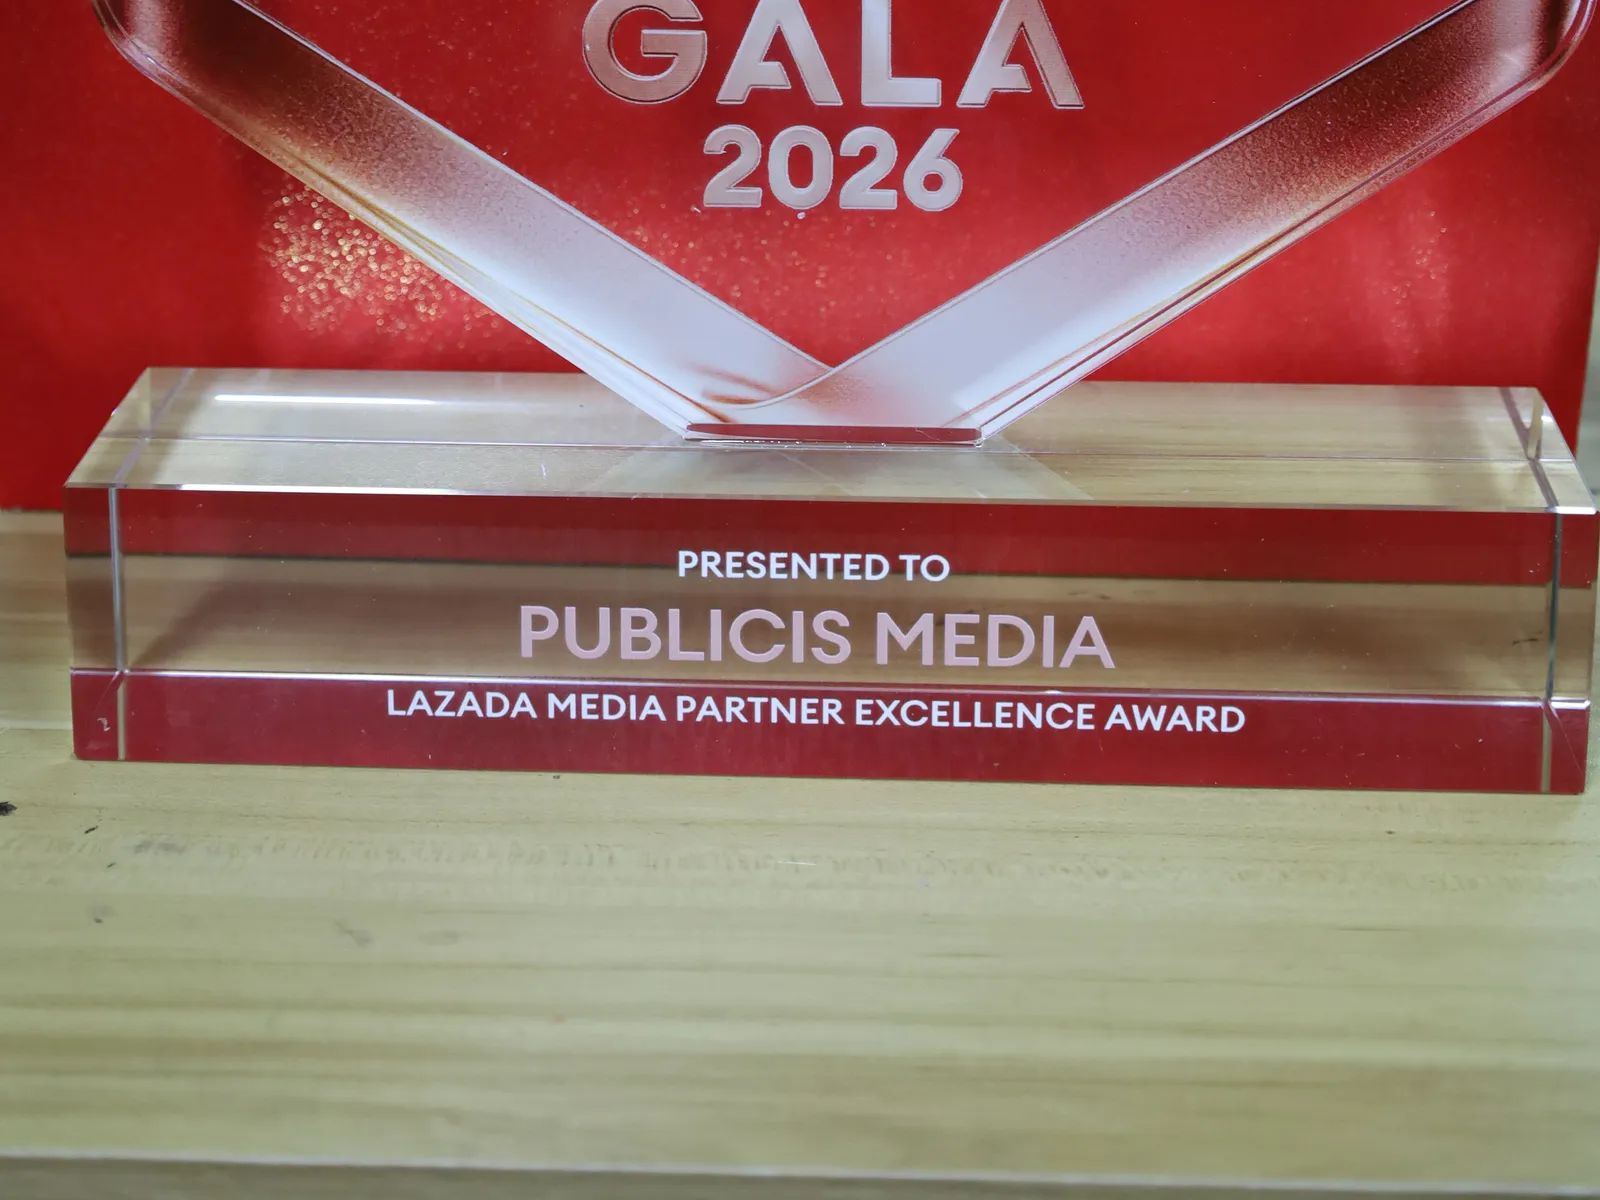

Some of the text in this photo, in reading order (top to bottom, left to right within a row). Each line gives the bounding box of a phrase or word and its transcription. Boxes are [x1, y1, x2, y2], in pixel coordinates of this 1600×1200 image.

[703, 124, 963, 212] 2026
[678, 550, 951, 582] PRESENTED TO
[520, 605, 1116, 669] PUBLICIS MEDIA
[387, 689, 1246, 733] LAZADA MEDIA PARTNER EXCELLENCE AWARD
